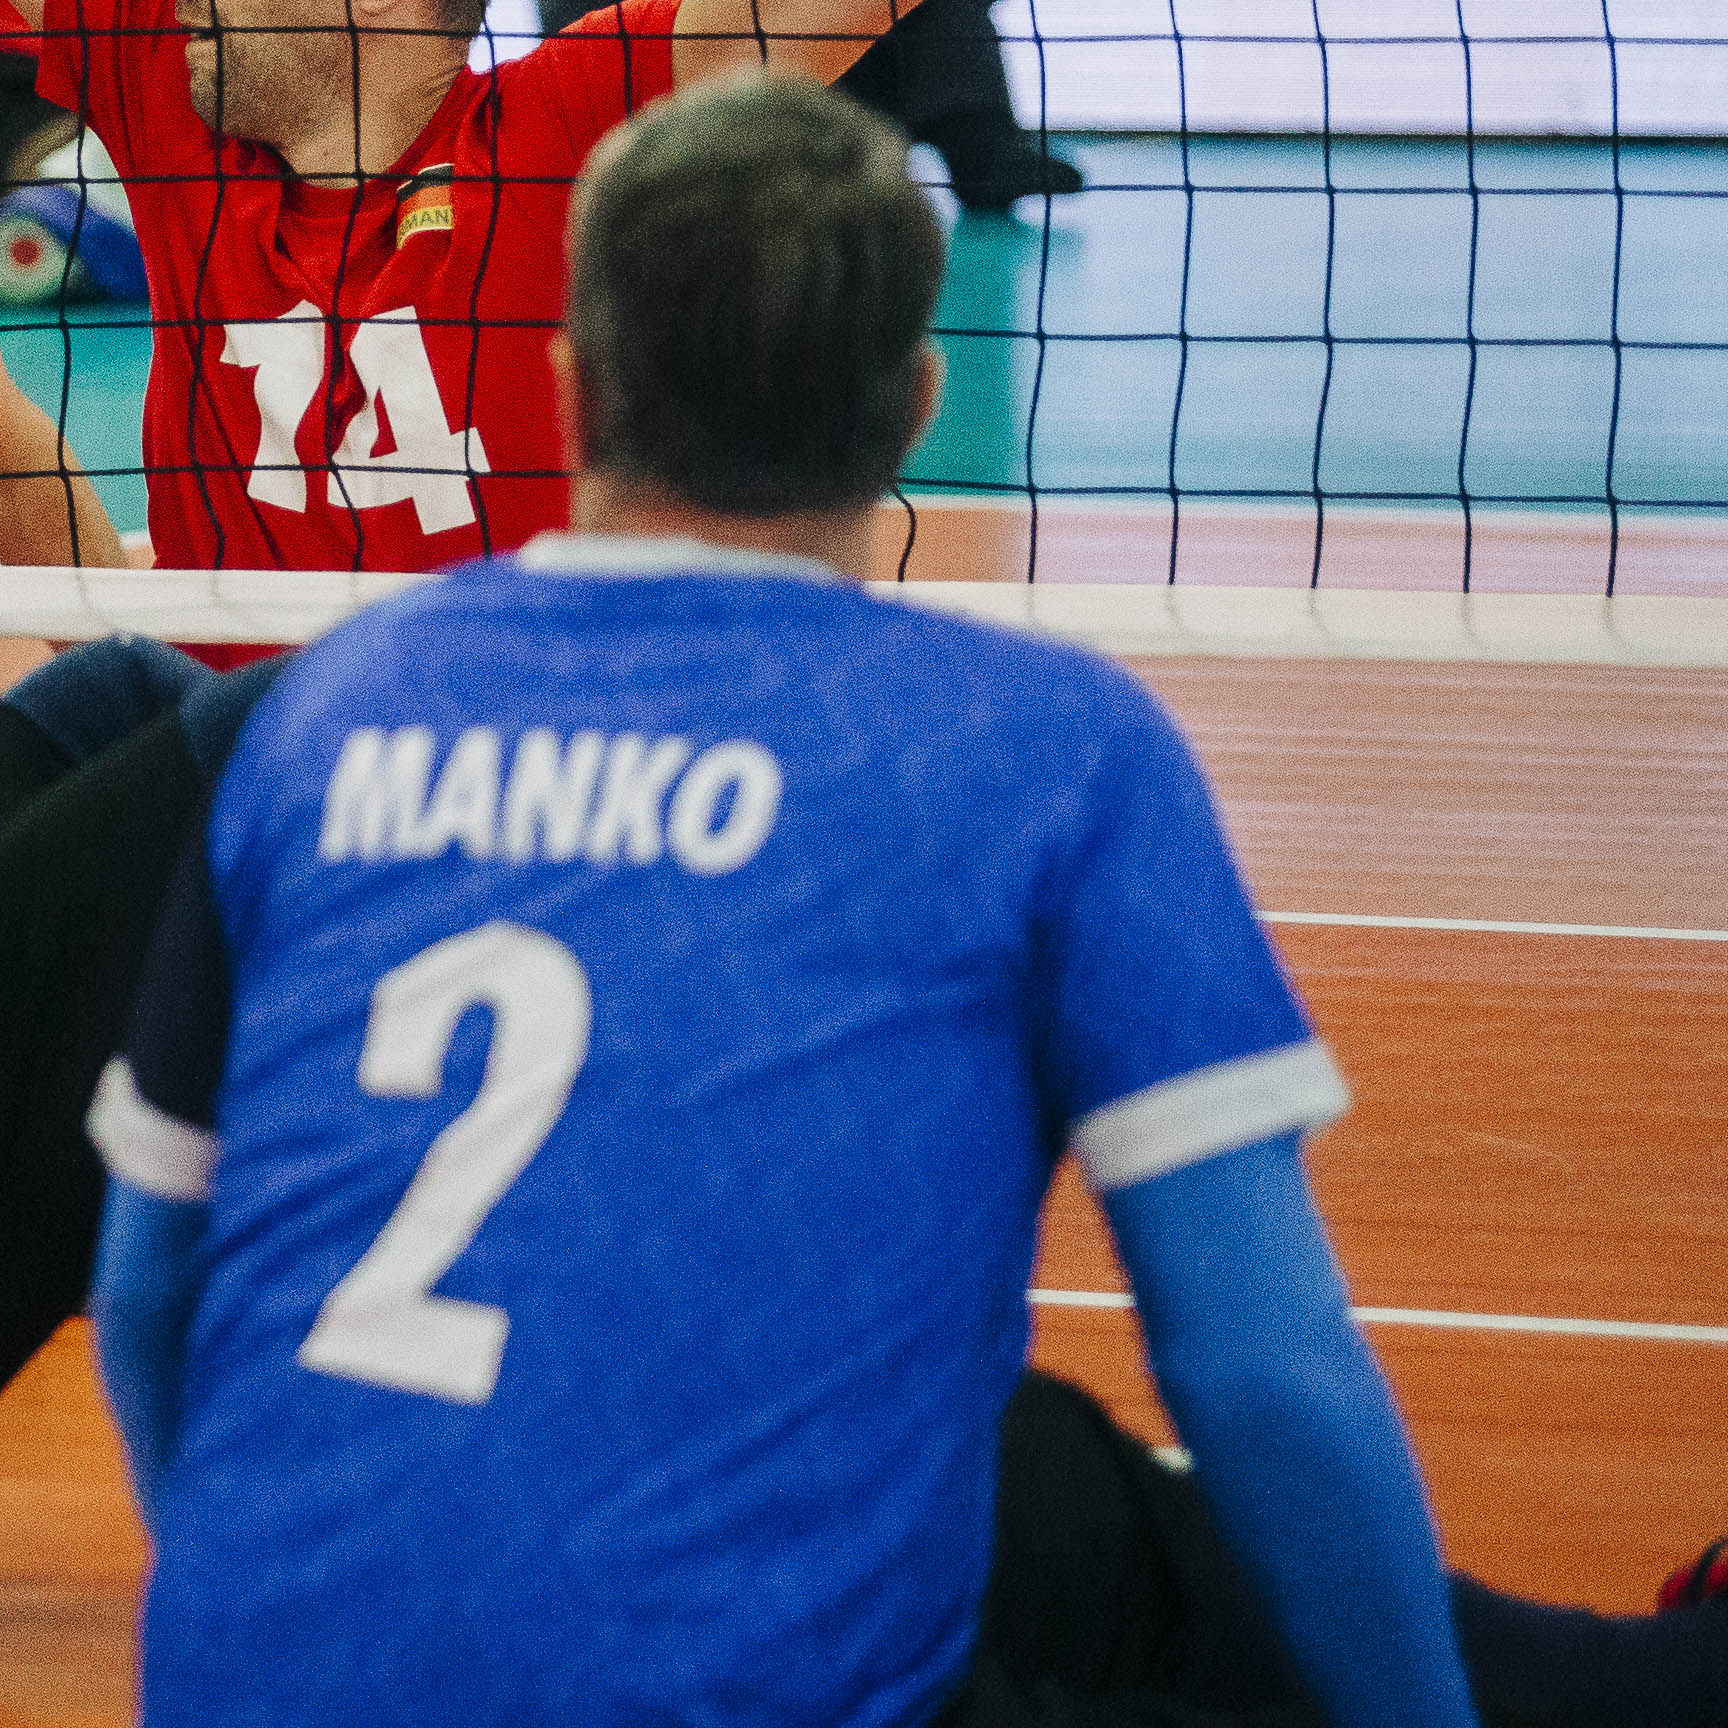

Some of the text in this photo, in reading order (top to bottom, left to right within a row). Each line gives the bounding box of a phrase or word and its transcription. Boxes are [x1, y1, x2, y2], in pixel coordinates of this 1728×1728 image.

[218, 299, 493, 535] 14
[320, 724, 784, 877] MANKO
[297, 920, 593, 1405] 2
